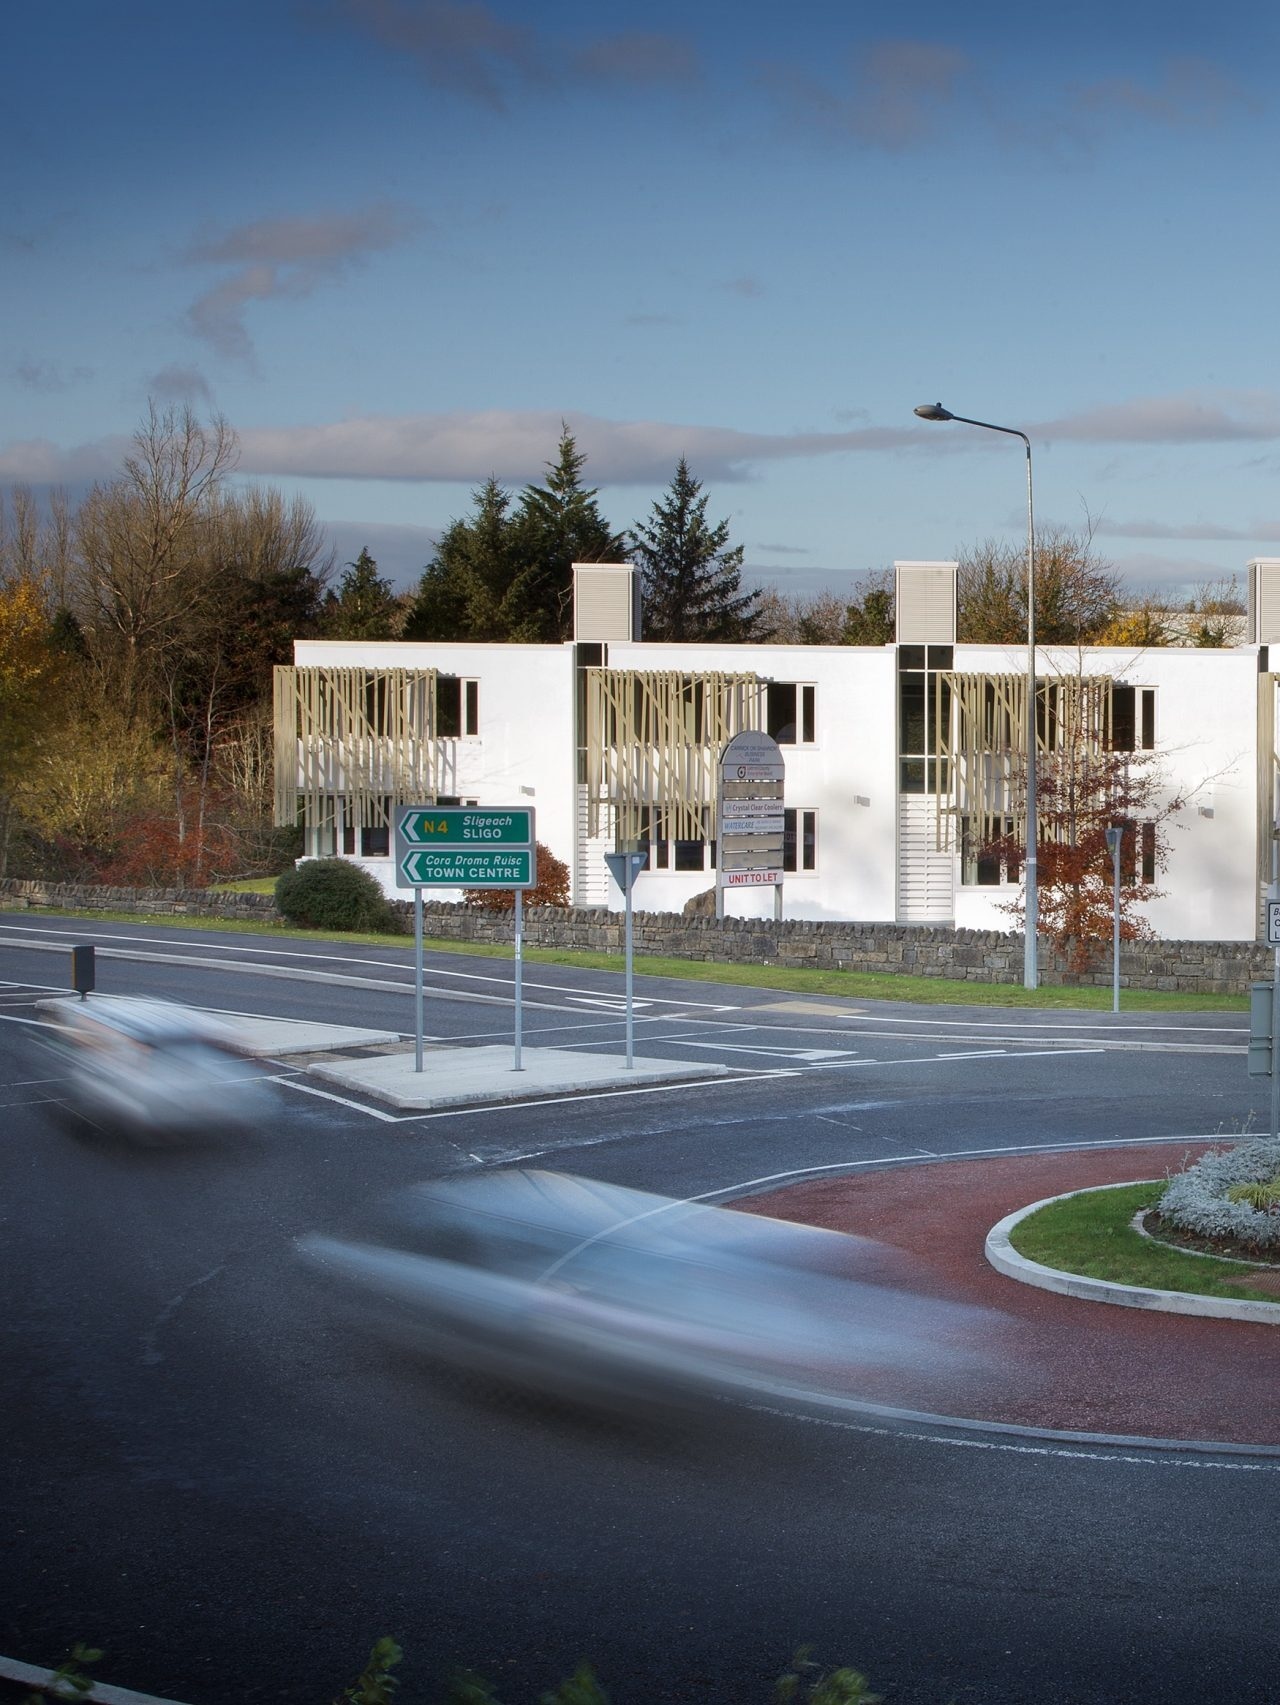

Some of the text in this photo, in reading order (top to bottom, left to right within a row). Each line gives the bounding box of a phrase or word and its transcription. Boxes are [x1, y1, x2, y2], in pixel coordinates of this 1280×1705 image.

[732, 803, 783, 812] Crystal Clear Coolers
[463, 815, 513, 827] Sligeach
[423, 820, 449, 834] N4
[463, 828, 502, 839] SLIGO
[425, 855, 522, 865] Cora Droma Rúisc
[426, 867, 520, 878] TOWN CENTRE
[728, 872, 778, 884] UNIT TO LET
